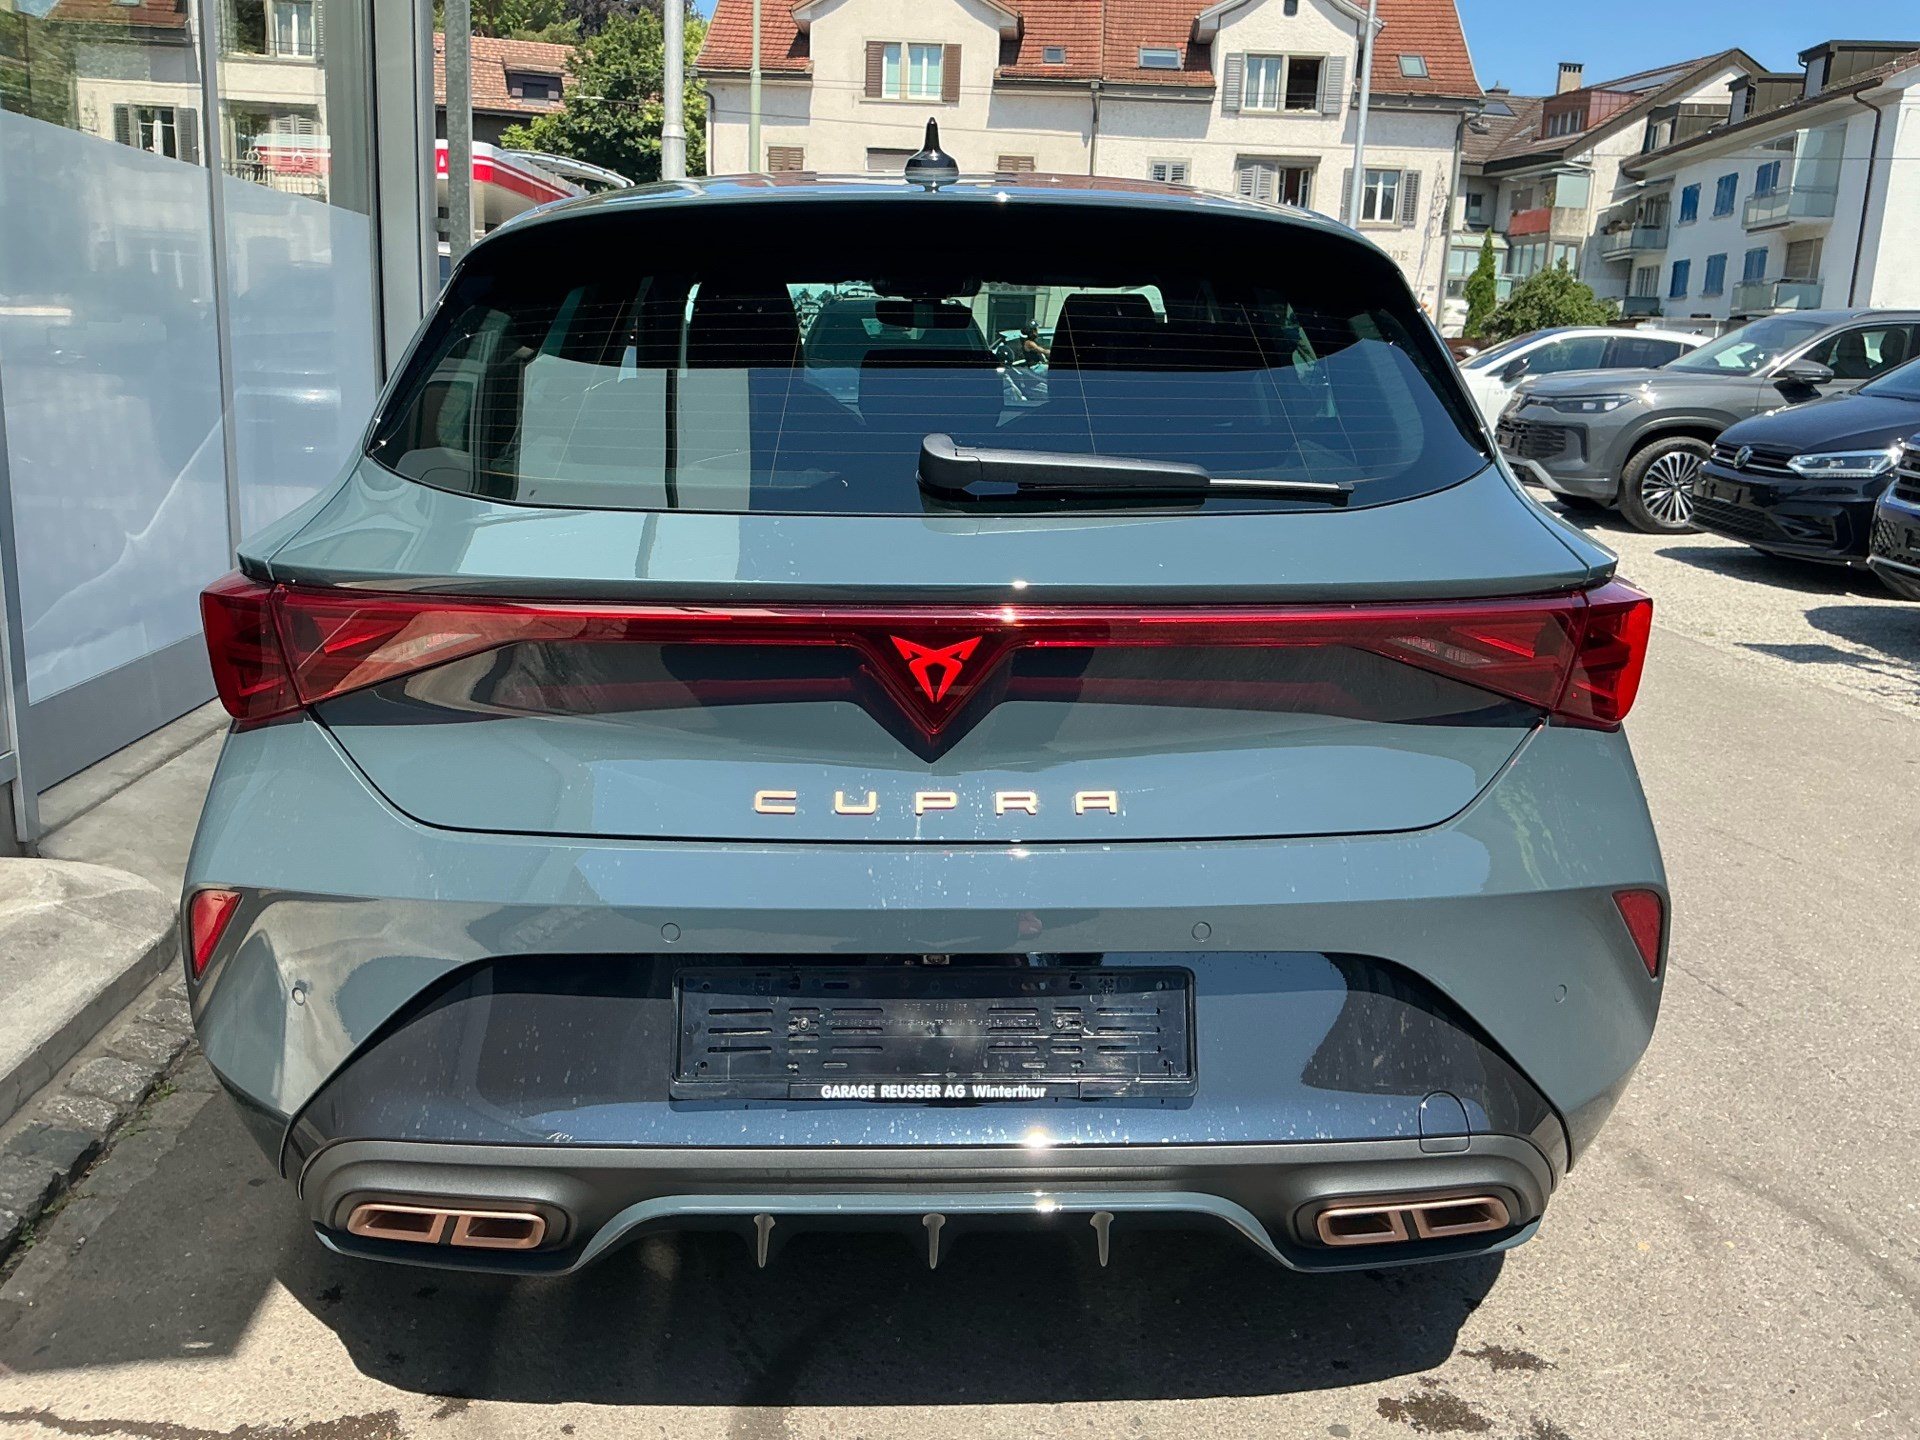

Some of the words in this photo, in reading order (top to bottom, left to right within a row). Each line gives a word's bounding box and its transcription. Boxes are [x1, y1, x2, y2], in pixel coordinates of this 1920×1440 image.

[755, 790, 1116, 815] CUPRA
[821, 1084, 876, 1099] GARAGE
[880, 1084, 941, 1098] REUSSER
[944, 1084, 966, 1098] AG
[972, 1084, 1047, 1098] Winterthur
